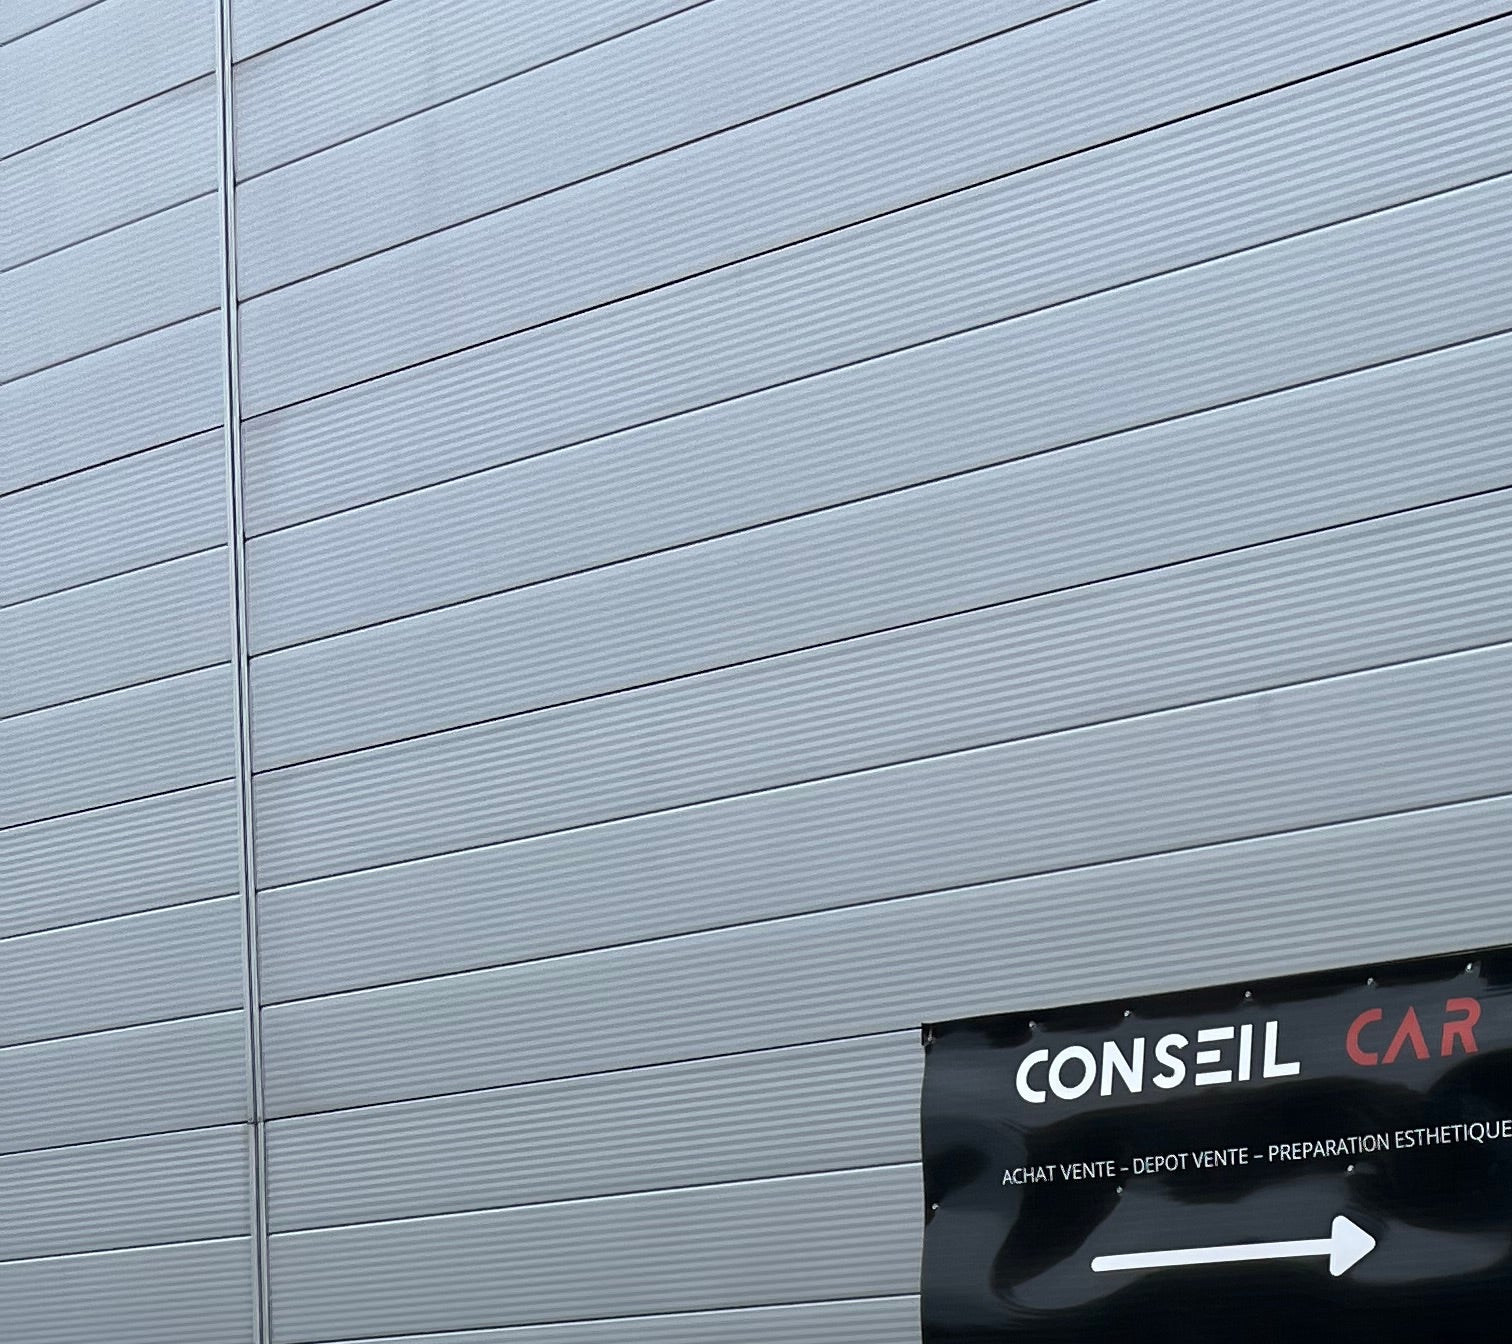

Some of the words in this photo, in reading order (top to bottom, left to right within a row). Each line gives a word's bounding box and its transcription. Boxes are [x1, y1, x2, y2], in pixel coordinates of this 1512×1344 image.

[1016, 1020, 1300, 1103] CONSEIL
[1346, 997, 1482, 1066] CAR
[1002, 1165, 1056, 1185] ACHAT
[1060, 1160, 1116, 1181] VENTE
[1133, 1154, 1188, 1175] DEPOT
[1192, 1148, 1248, 1168] VENTE
[1268, 1133, 1390, 1162] PREPARATION
[1395, 1119, 1512, 1149] ESTHETIQUE
